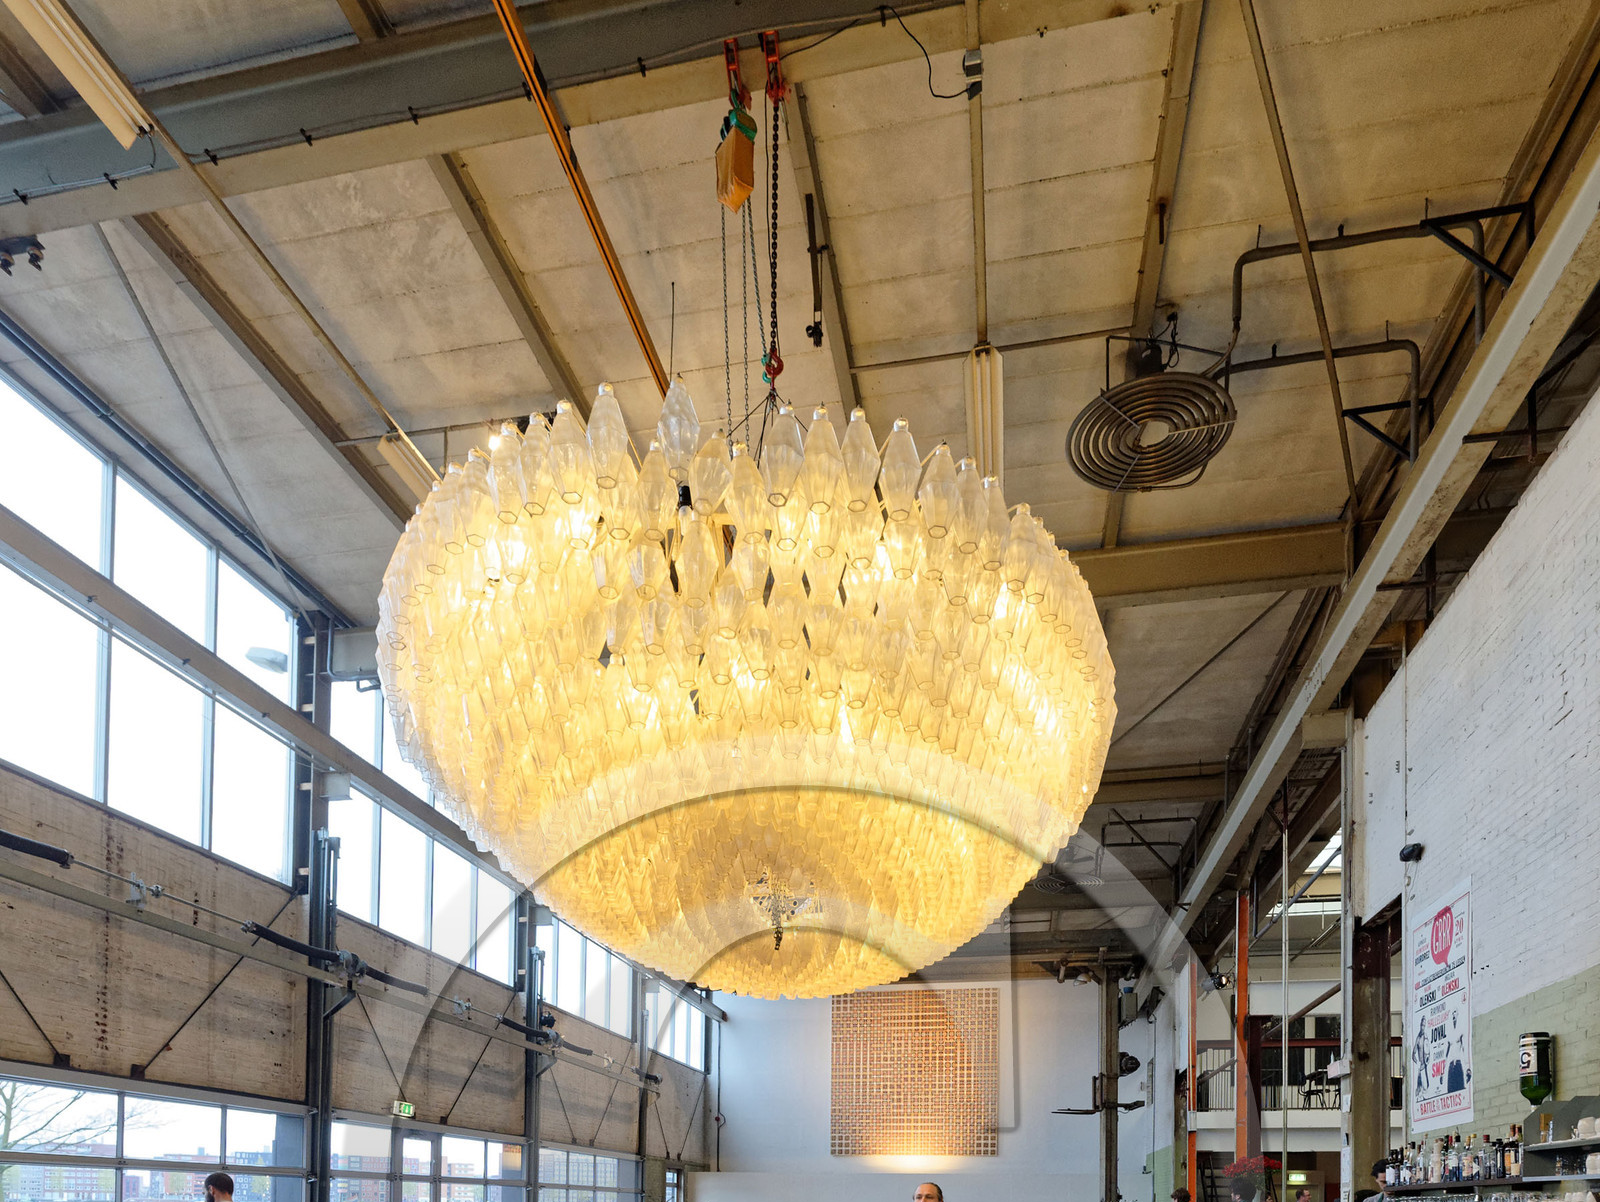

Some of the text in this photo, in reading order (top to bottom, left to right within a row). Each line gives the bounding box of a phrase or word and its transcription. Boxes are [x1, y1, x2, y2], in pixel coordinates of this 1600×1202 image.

[1433, 913, 1451, 954] GRRR
[1454, 917, 1464, 936] 20
[1431, 1023, 1446, 1044] JOVAL
[1519, 1052, 1532, 1069] 5
[1420, 1100, 1436, 1115] BATTLE
[1440, 1093, 1462, 1109] TACTICS
